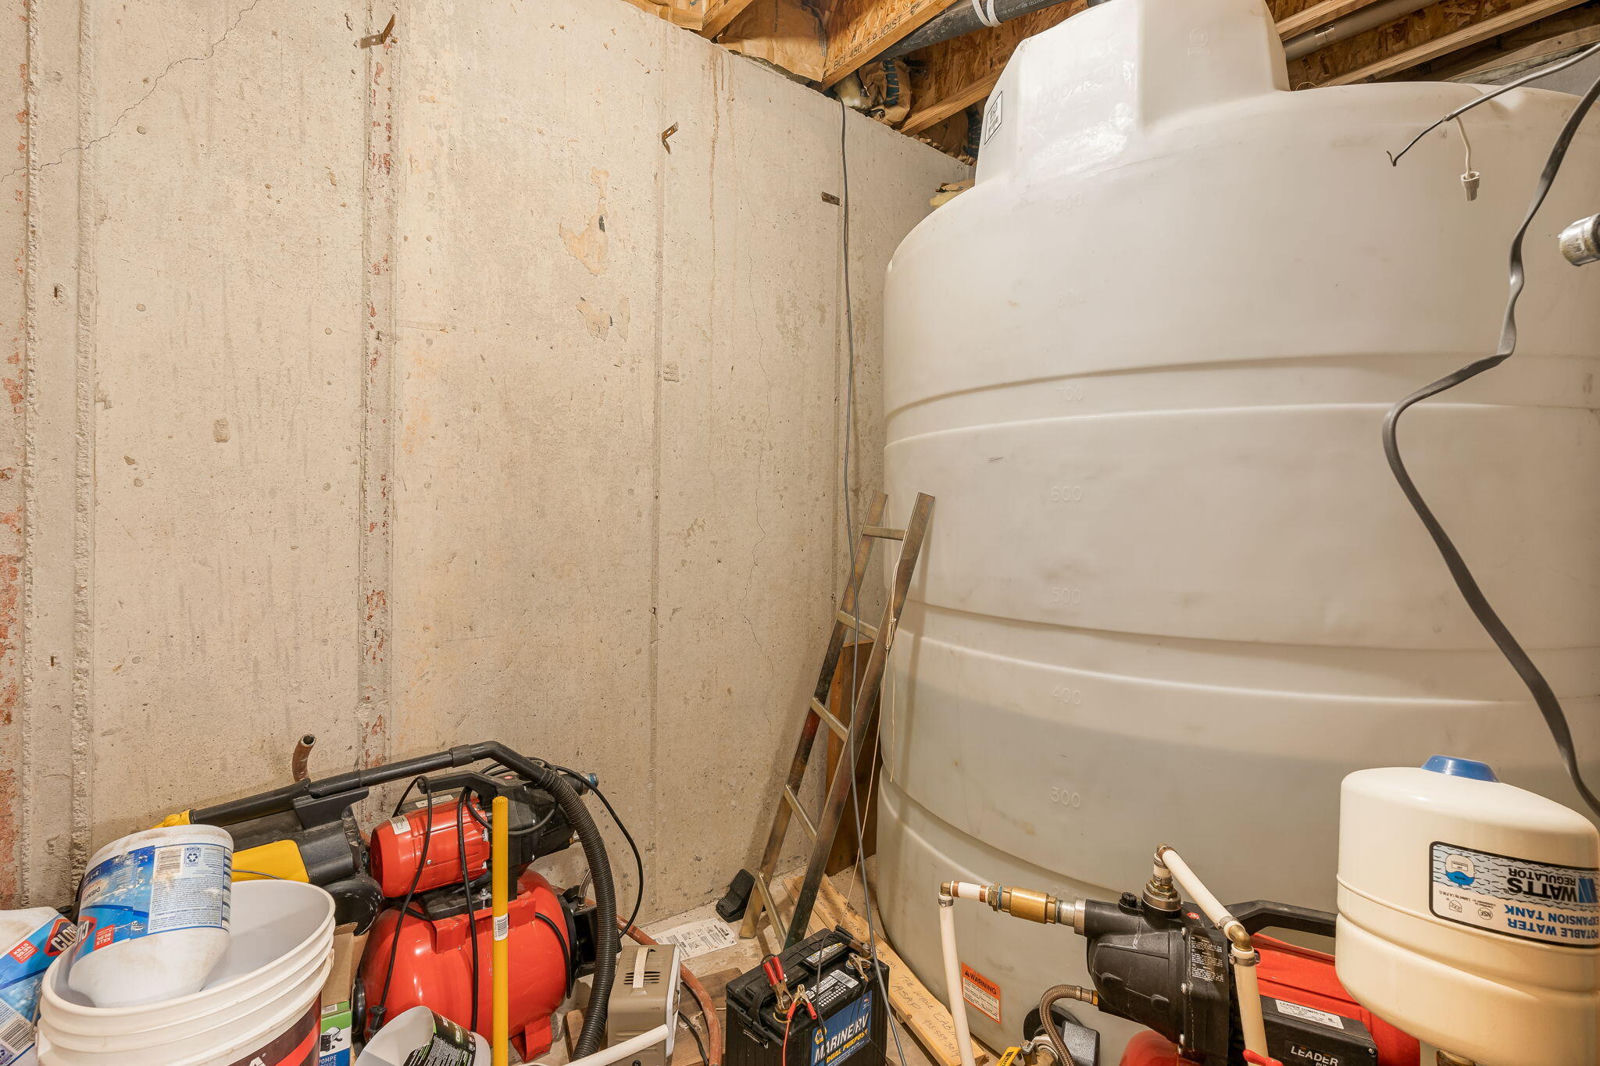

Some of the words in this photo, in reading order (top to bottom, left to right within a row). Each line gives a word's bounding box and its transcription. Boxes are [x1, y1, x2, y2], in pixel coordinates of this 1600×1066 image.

[1509, 868, 1576, 886] REGULATOR
[1508, 877, 1577, 903] WATTS
[1504, 904, 1545, 921] TANK
[1548, 911, 1600, 929] EXPANSION
[1507, 917, 1558, 937] WATER
[1559, 924, 1600, 940] POTABLE
[969, 973, 997, 995] WARNING
[1290, 1045, 1339, 1066] LEADER
